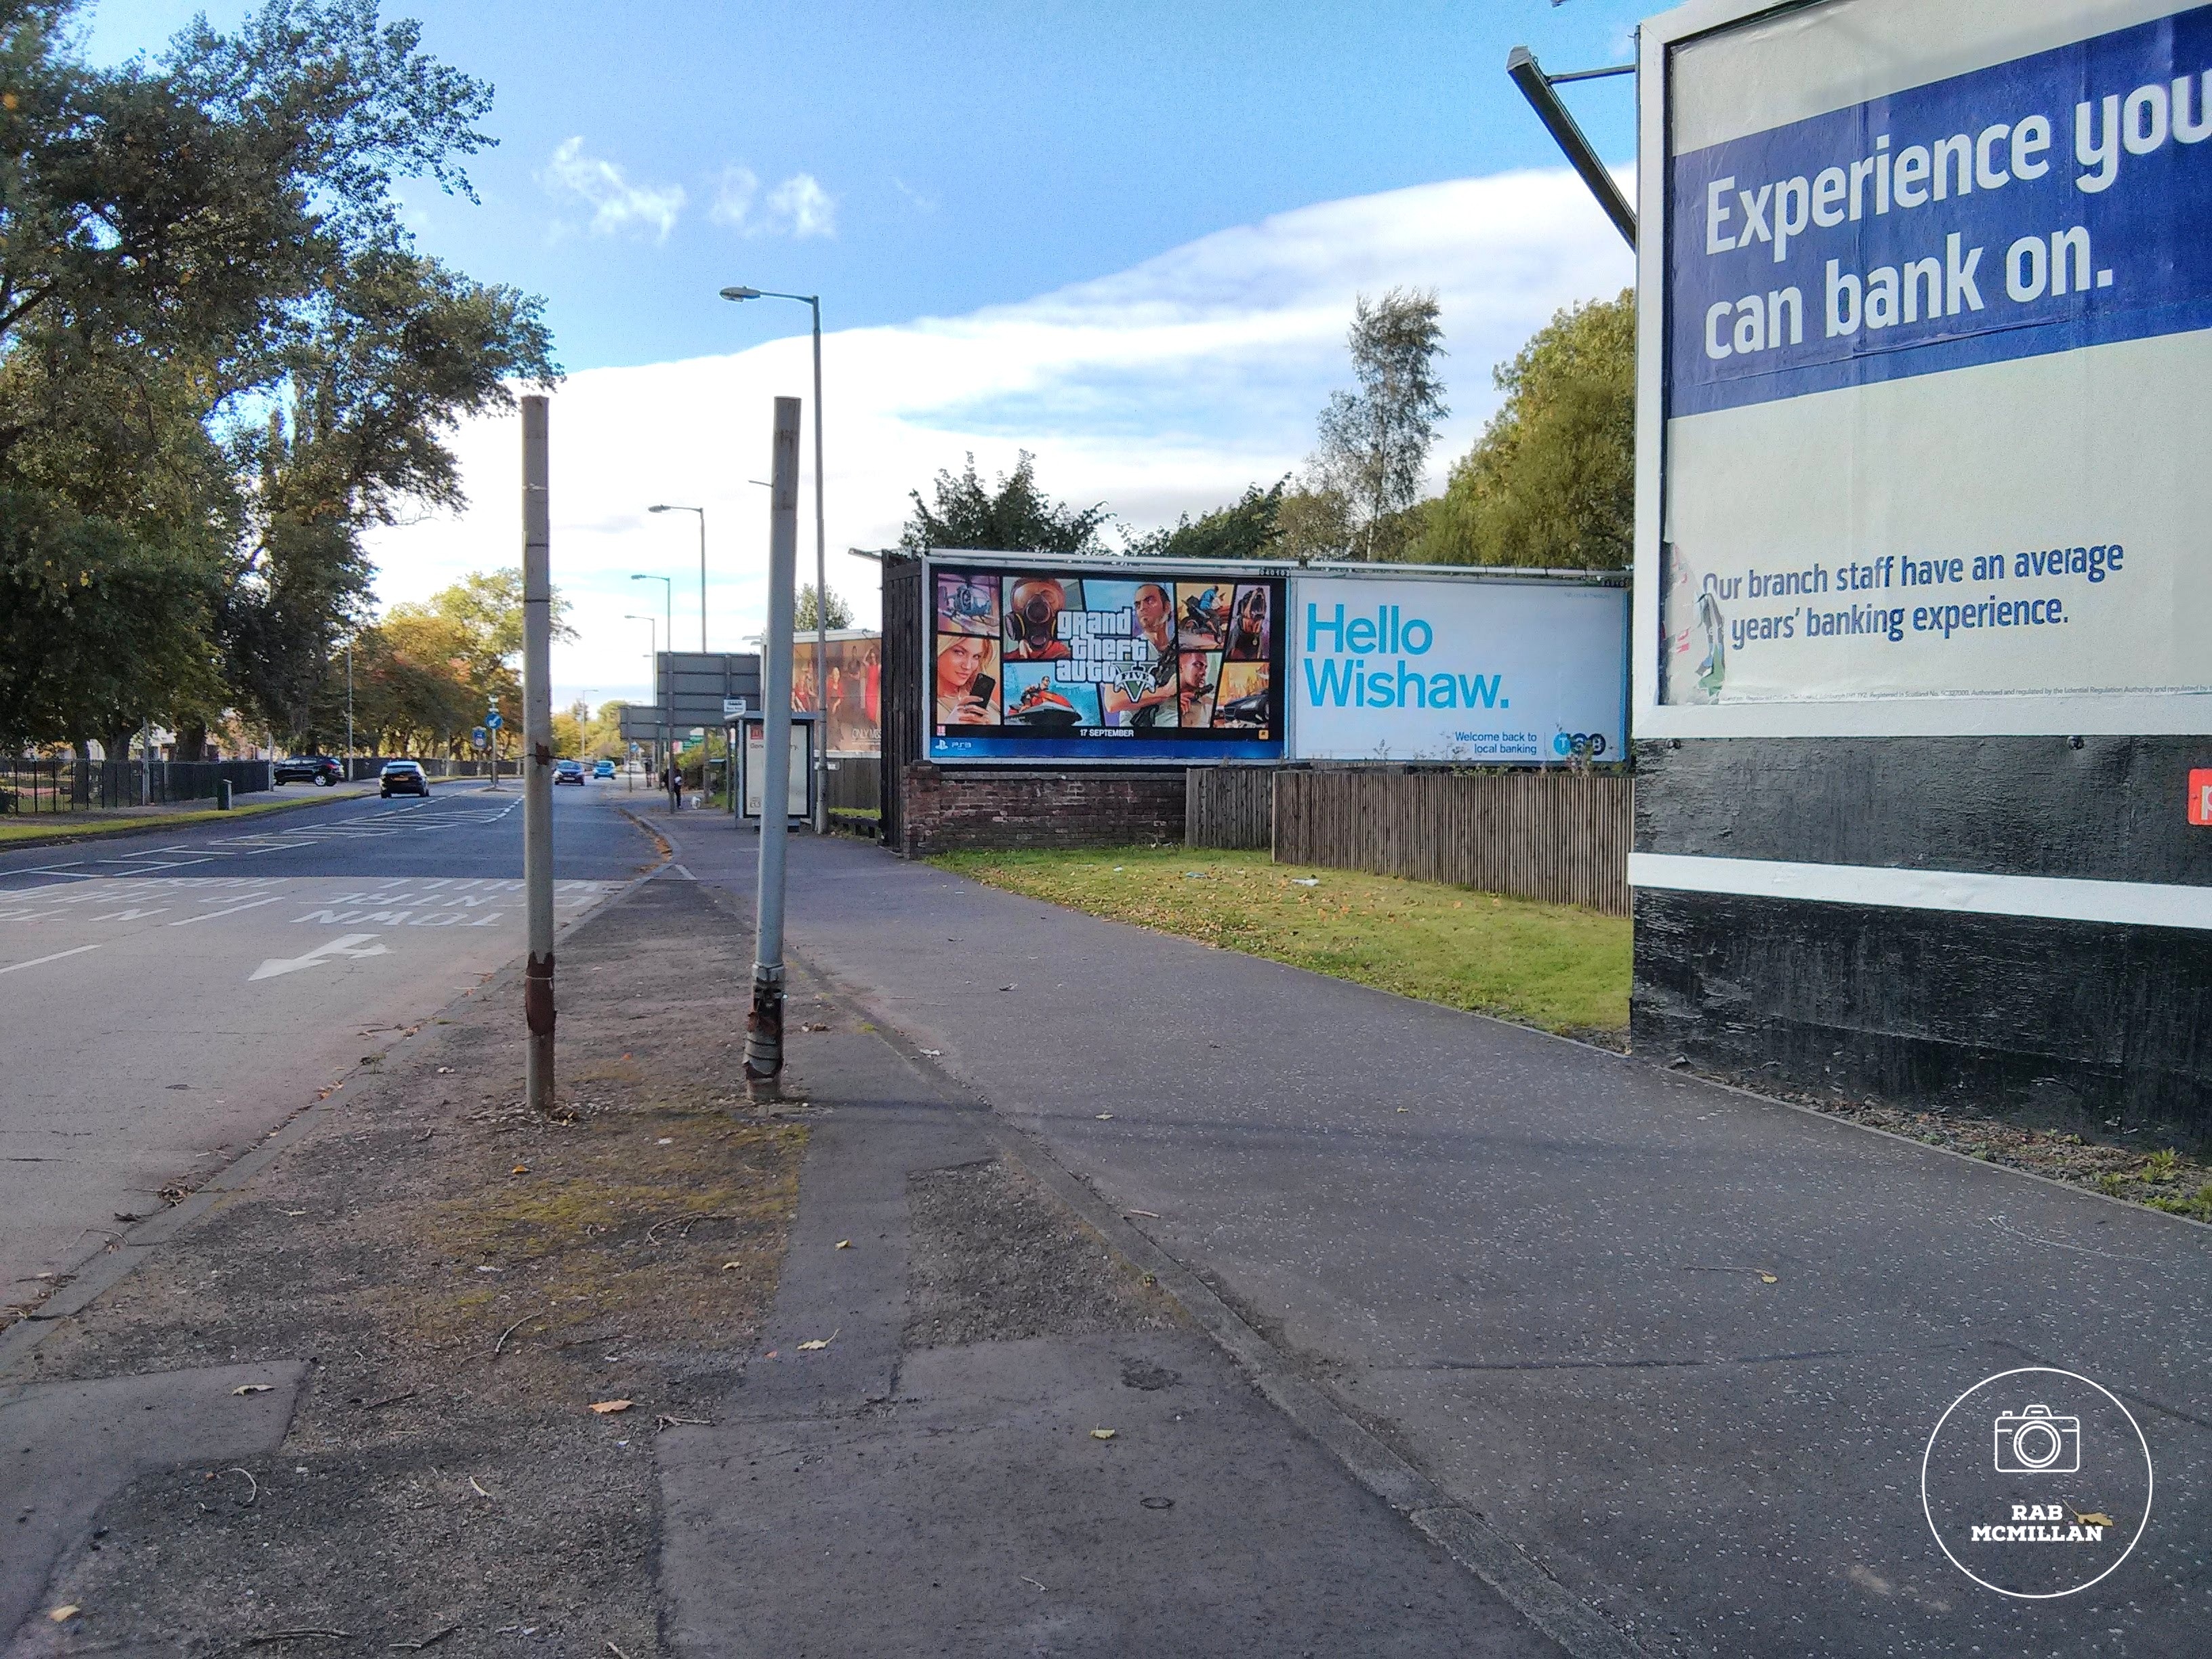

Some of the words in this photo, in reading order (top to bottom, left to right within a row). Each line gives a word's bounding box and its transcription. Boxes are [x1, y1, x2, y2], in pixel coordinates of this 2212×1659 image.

[1706, 114, 2049, 263] Experience
[2075, 66, 2212, 193] you
[1705, 279, 1803, 360] can
[1826, 232, 1984, 340] bank
[2005, 224, 2113, 303] on.
[1703, 573, 1742, 600] Our
[1748, 563, 1828, 599] branch
[1836, 556, 1894, 592] staff
[1901, 554, 1963, 587] have
[1973, 550, 2006, 581] an
[2014, 543, 2125, 583] average
[1306, 602, 1433, 656] Hello
[1805, 603, 1906, 642] banking
[1912, 595, 2070, 638] experience.
[1303, 657, 1510, 710] Wishaw.
[1080, 729, 1088, 737] 17
[1089, 729, 1134, 737] SEPTEMBER
[1455, 731, 1502, 742] Welcome
[1502, 732, 1525, 742] back
[1528, 733, 1537, 742] to
[1474, 743, 1497, 754] local
[1500, 743, 1537, 755] banking
